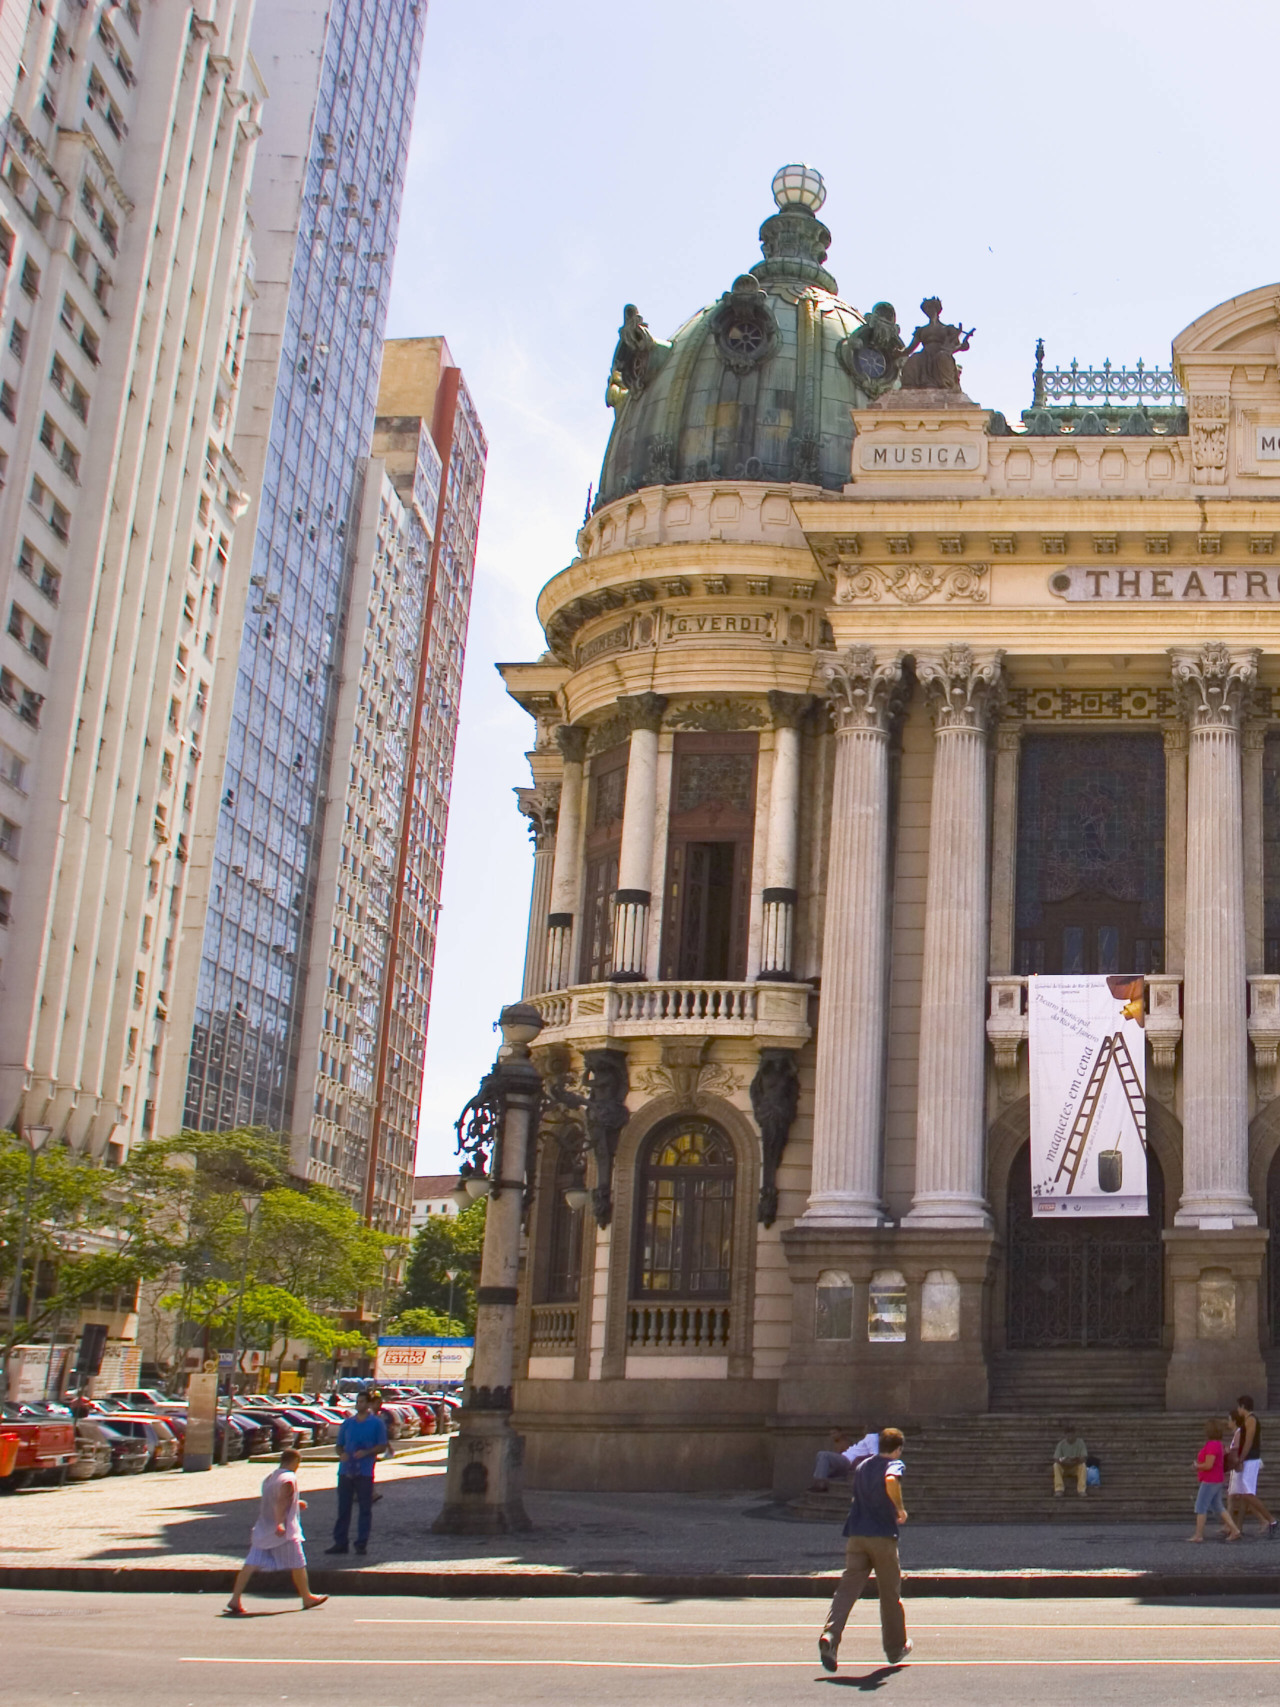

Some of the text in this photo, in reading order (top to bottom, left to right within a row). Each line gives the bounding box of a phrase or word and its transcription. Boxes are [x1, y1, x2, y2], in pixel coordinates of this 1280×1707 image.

[874, 448, 966, 464] MUSICA
[1035, 994, 1091, 1029] Theatro Municipal
[1050, 1013, 1100, 1043] do Rio de Janeiro
[1046, 1101, 1074, 1163] maquetes
[1068, 1079, 1082, 1100] em
[1076, 1046, 1094, 1077] cena
